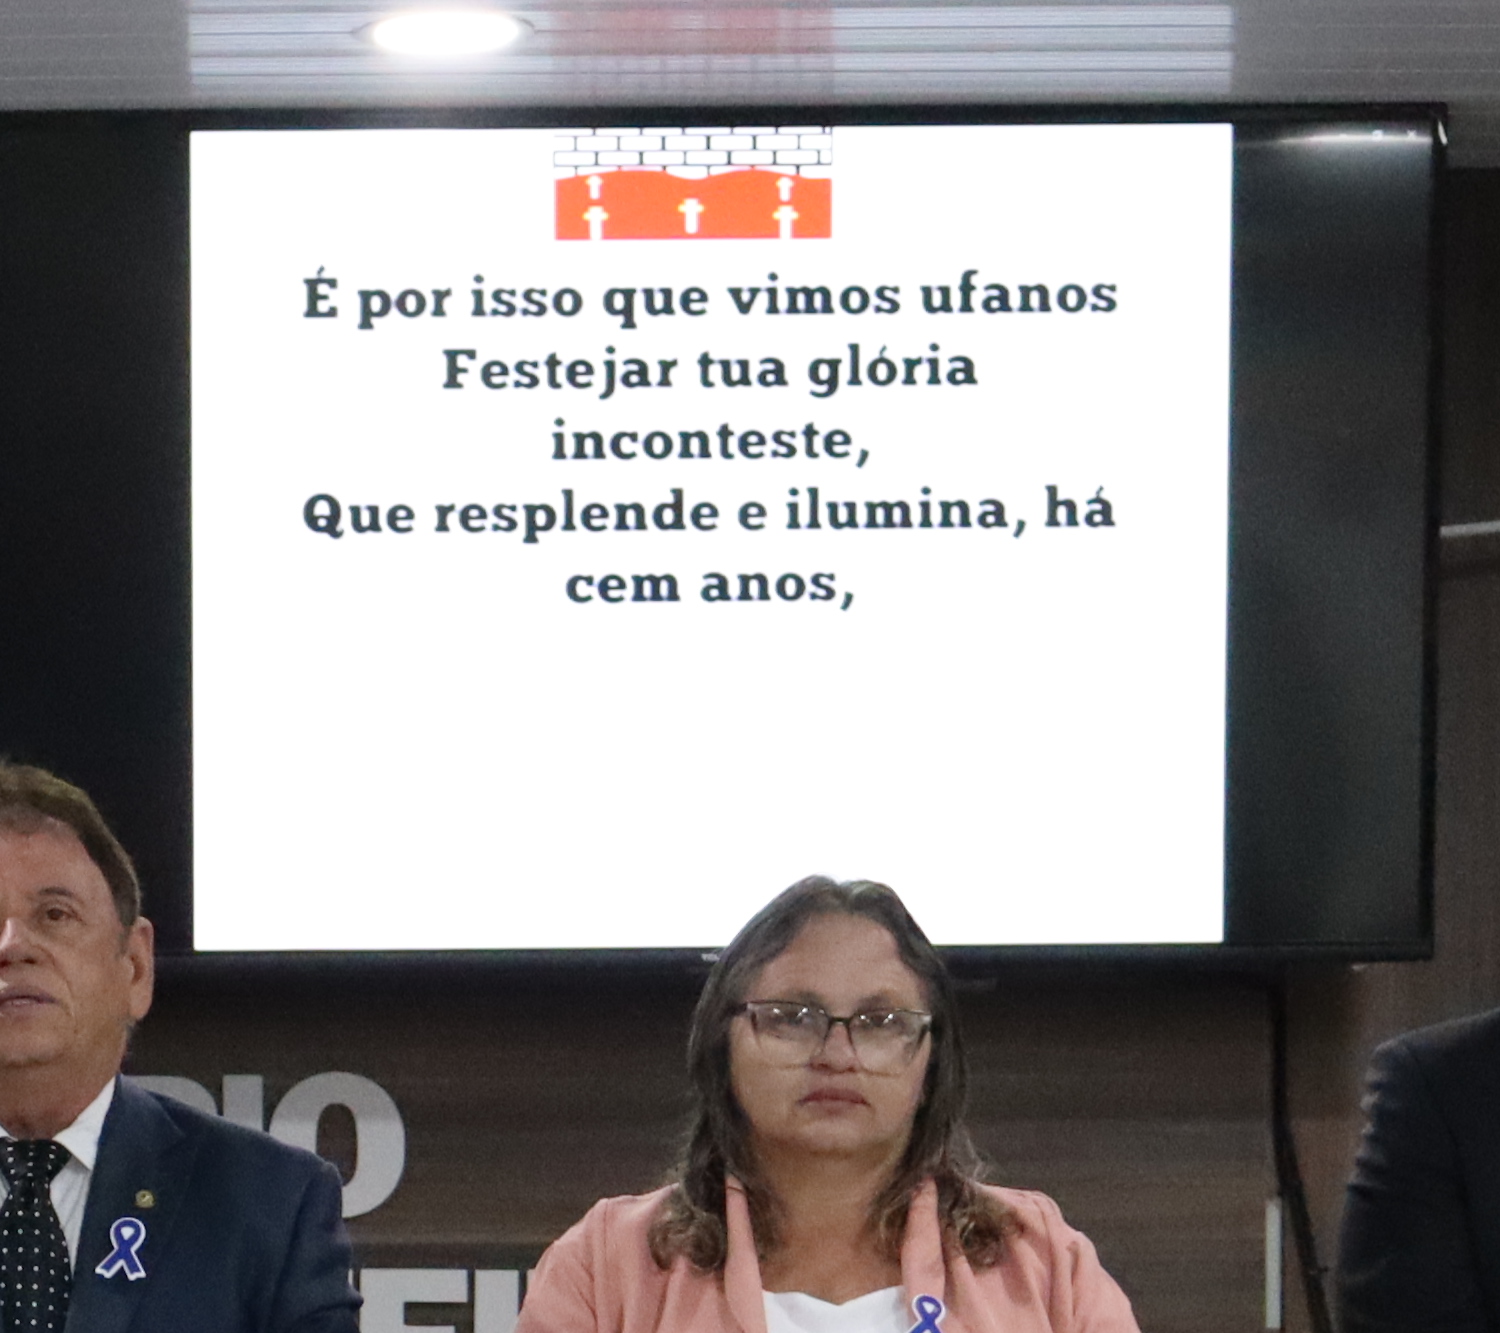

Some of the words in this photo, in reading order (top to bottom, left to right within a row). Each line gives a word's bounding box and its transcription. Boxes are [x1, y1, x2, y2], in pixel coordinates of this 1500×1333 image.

[305, 267, 338, 318] É
[359, 290, 451, 329] por
[473, 276, 583, 317] isso
[605, 288, 708, 329] que
[729, 273, 900, 315] vimos
[921, 270, 1117, 314] ufanos
[443, 346, 678, 399] Festejar
[697, 353, 788, 388] tua
[809, 344, 978, 398] glória
[553, 418, 869, 467] inconteste,
[303, 494, 415, 538] Que
[435, 489, 719, 541] resplende
[740, 502, 767, 531] e
[787, 488, 1026, 537] ilumina,
[1045, 486, 1115, 528] há
[567, 574, 680, 603] cem
[701, 572, 853, 610] anos,
